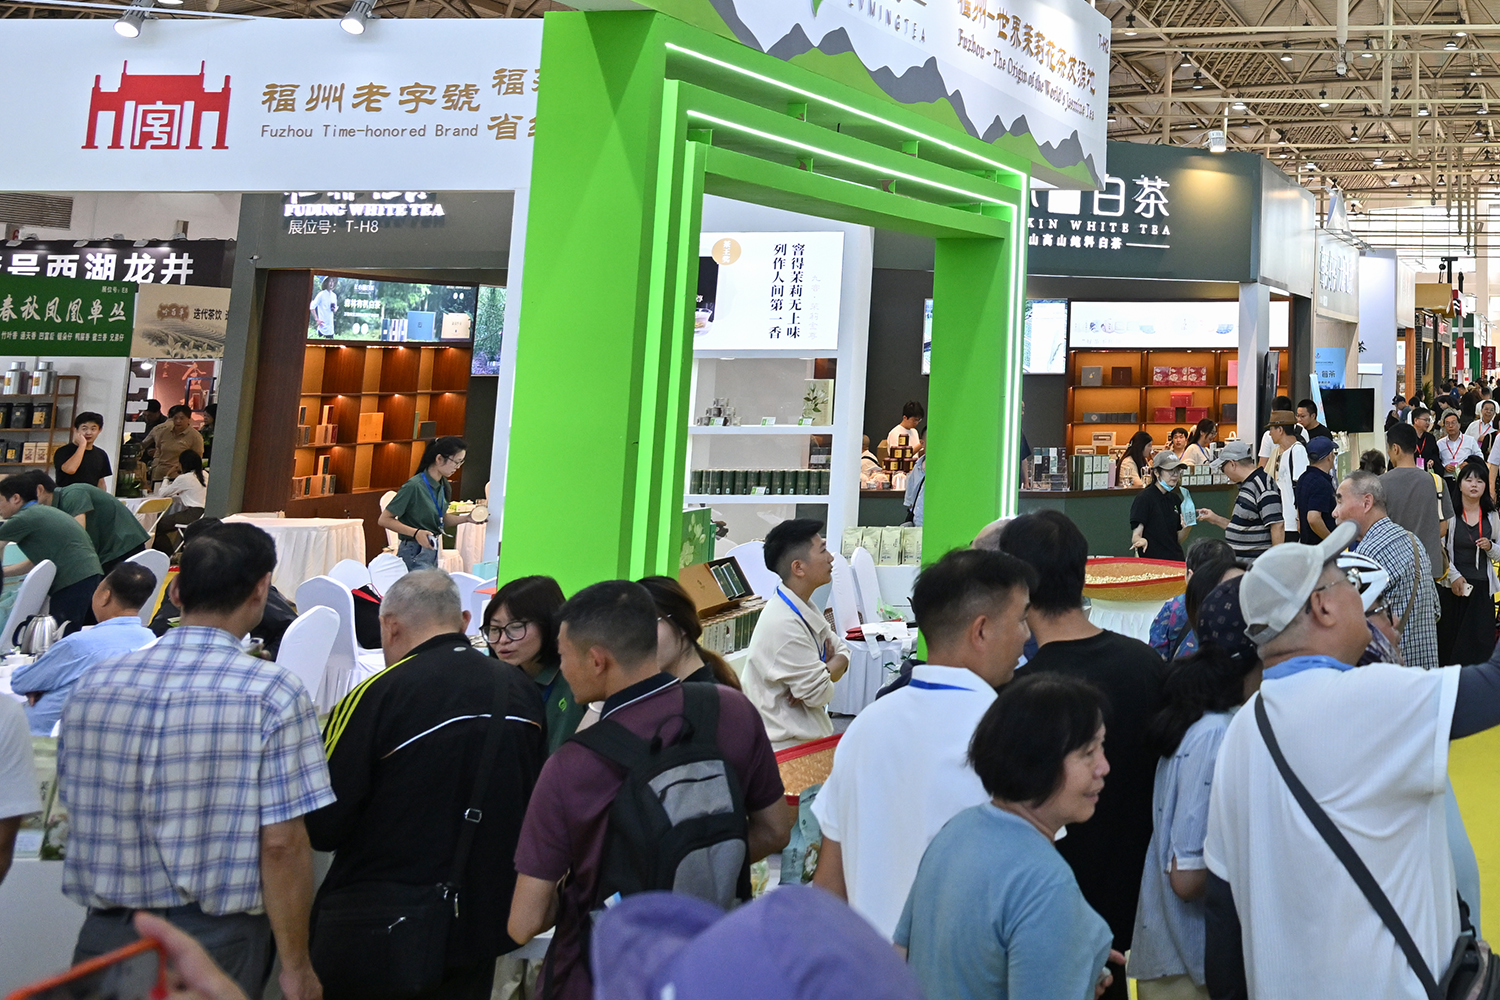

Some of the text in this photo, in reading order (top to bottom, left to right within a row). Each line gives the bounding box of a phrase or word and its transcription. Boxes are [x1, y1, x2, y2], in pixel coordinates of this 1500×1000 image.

[958, 28, 985, 60] Fuzhou
[993, 48, 1006, 71] The
[1007, 58, 1028, 85] Origin
[1028, 72, 1035, 88] of
[1035, 73, 1044, 93] the
[1064, 92, 1086, 115] Jasmine
[1086, 103, 1095, 121] Tea
[261, 82, 481, 113] 福州老字號
[261, 124, 479, 138] Fuzhou Time-honored Brand
[283, 203, 446, 217] FUDING WHITE TEA
[1070, 220, 1130, 233] WHITE
[1139, 224, 1171, 235] TEA
[0, 252, 194, 285] 号西湖龙井
[769, 243, 787, 339] 列作人间第一香
